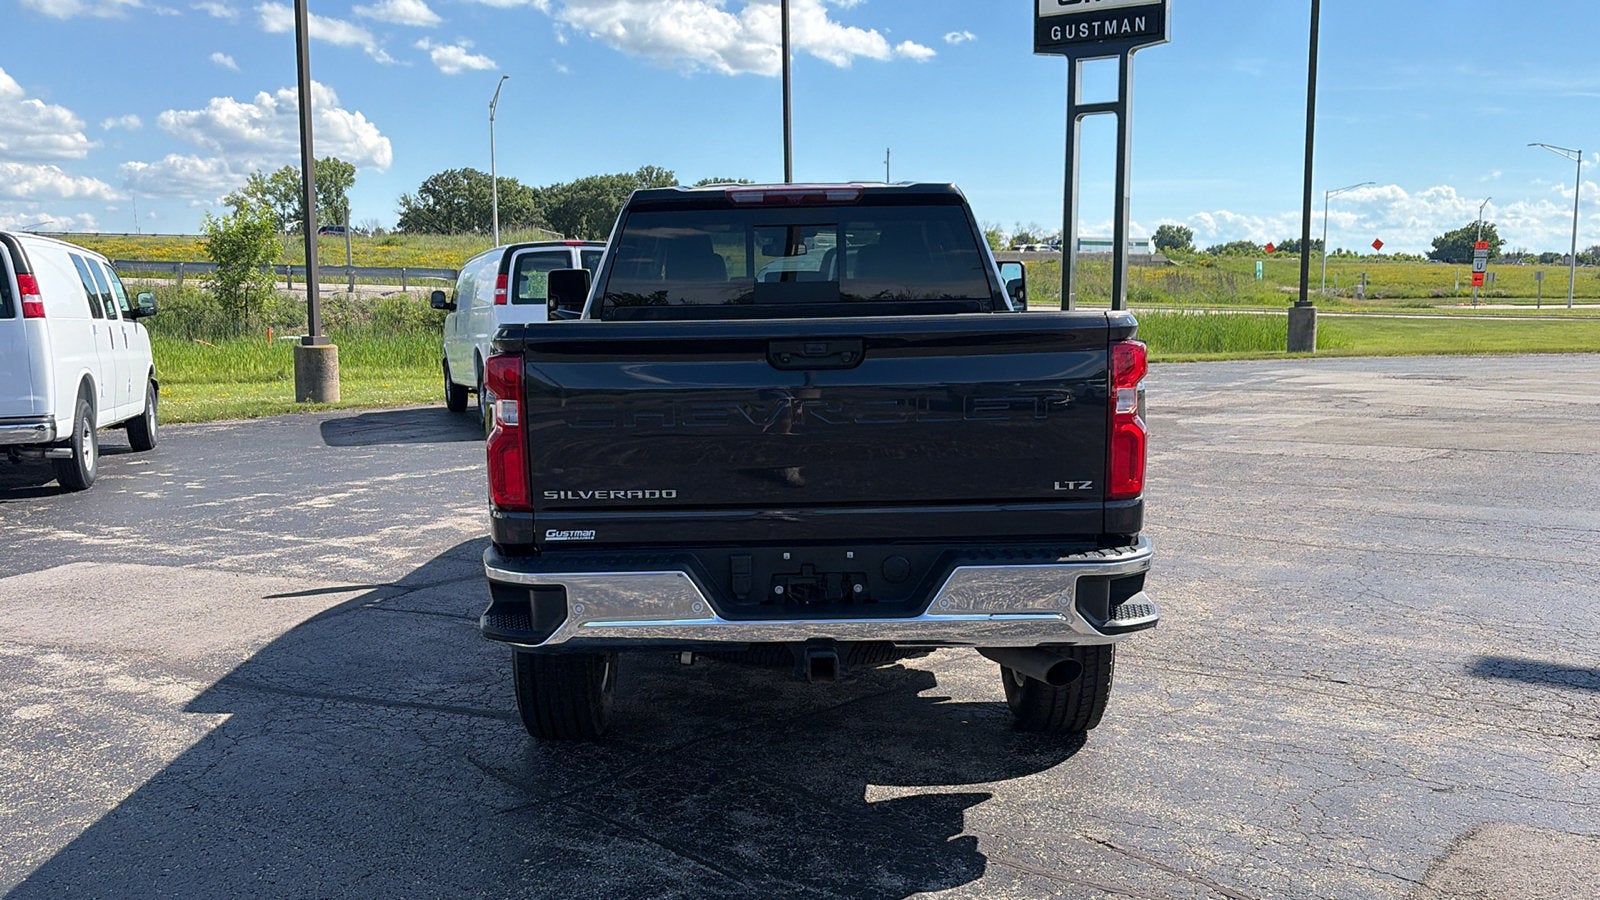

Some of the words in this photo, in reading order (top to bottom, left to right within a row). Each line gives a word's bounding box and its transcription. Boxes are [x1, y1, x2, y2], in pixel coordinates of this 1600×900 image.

[1051, 16, 1145, 40] GUSTMAN
[1477, 262, 1483, 270] U
[564, 391, 1073, 427] CHEVROLET
[1054, 480, 1093, 490] LTZ
[543, 490, 677, 500] SILVERADO
